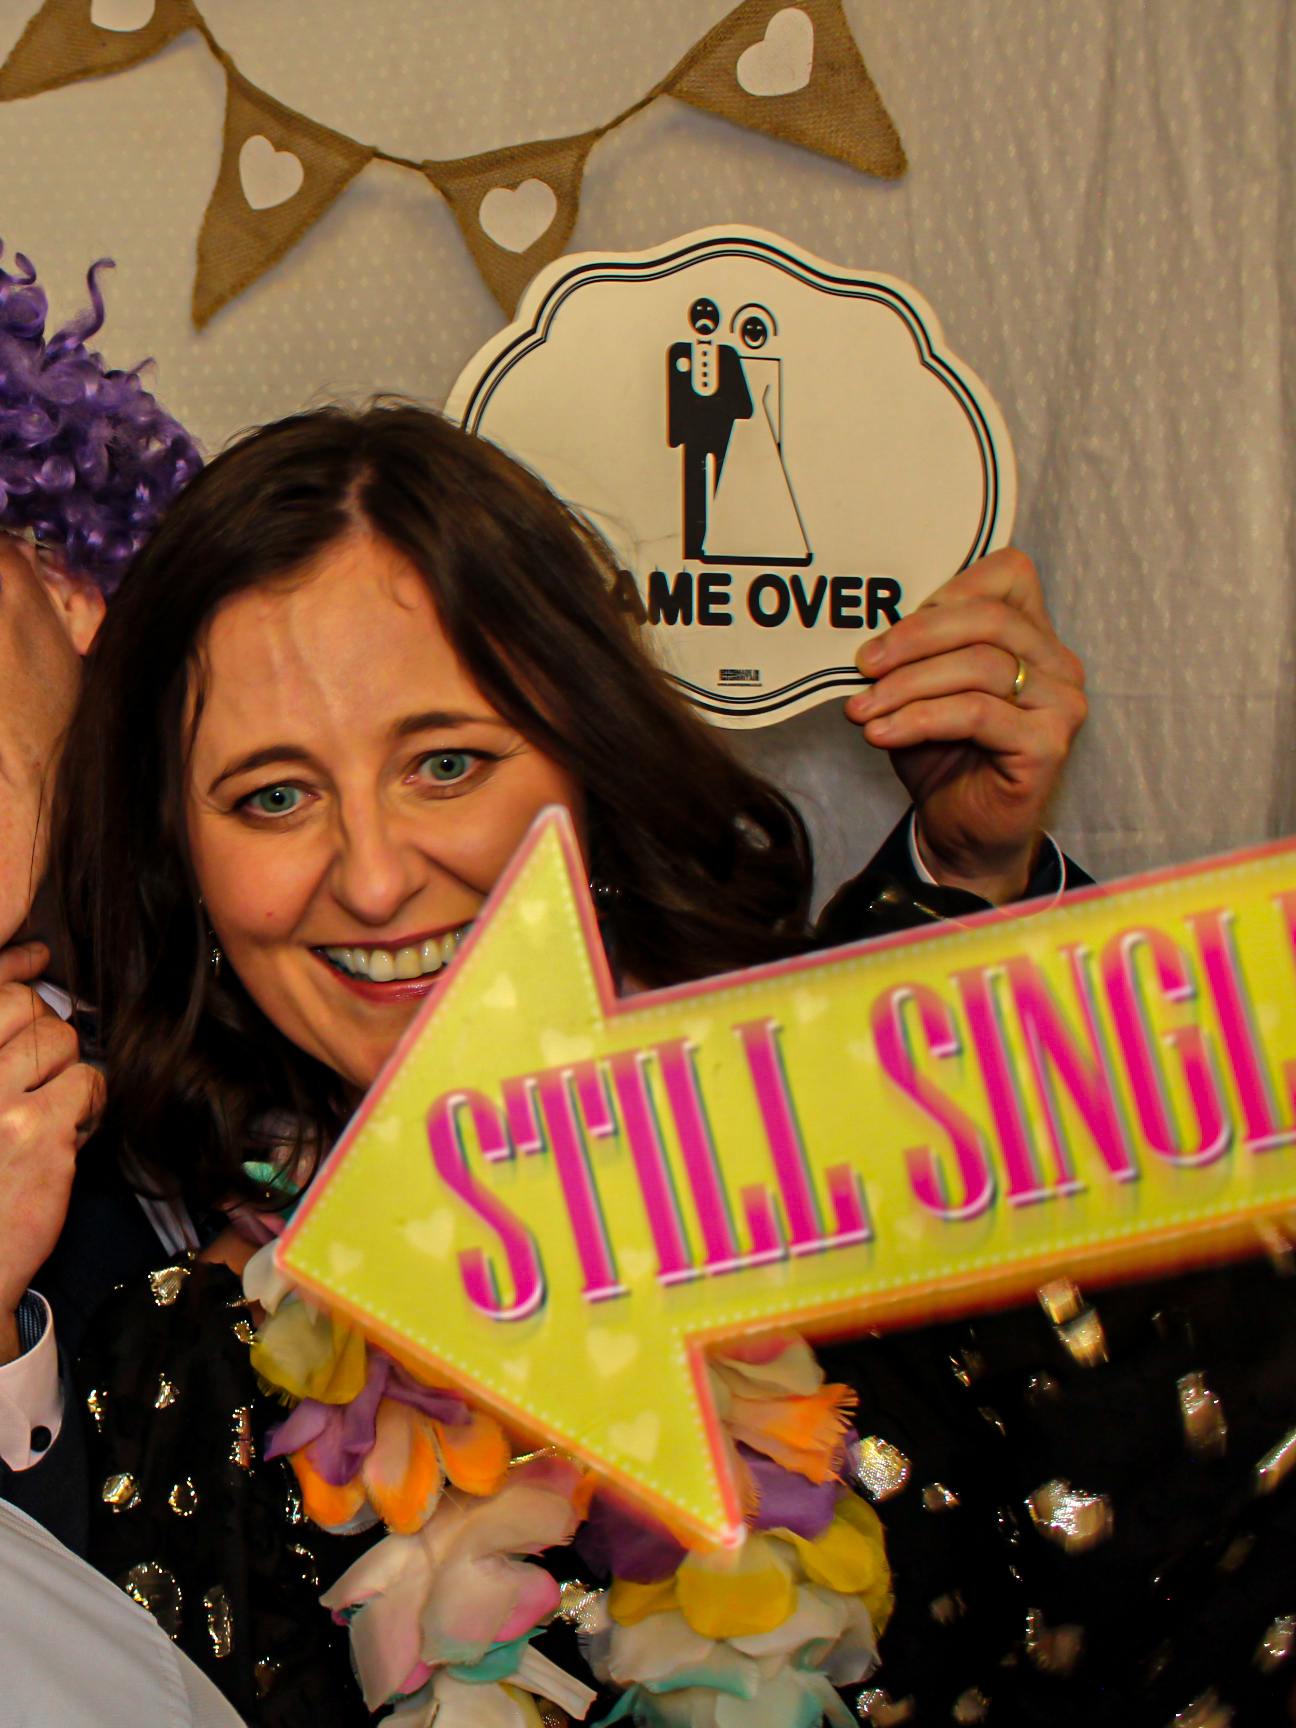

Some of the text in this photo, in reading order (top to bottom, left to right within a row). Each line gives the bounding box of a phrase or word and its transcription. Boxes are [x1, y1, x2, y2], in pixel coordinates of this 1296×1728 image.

[603, 569, 903, 630] AME OVER
[425, 892, 1296, 1321] STILL SINGL
